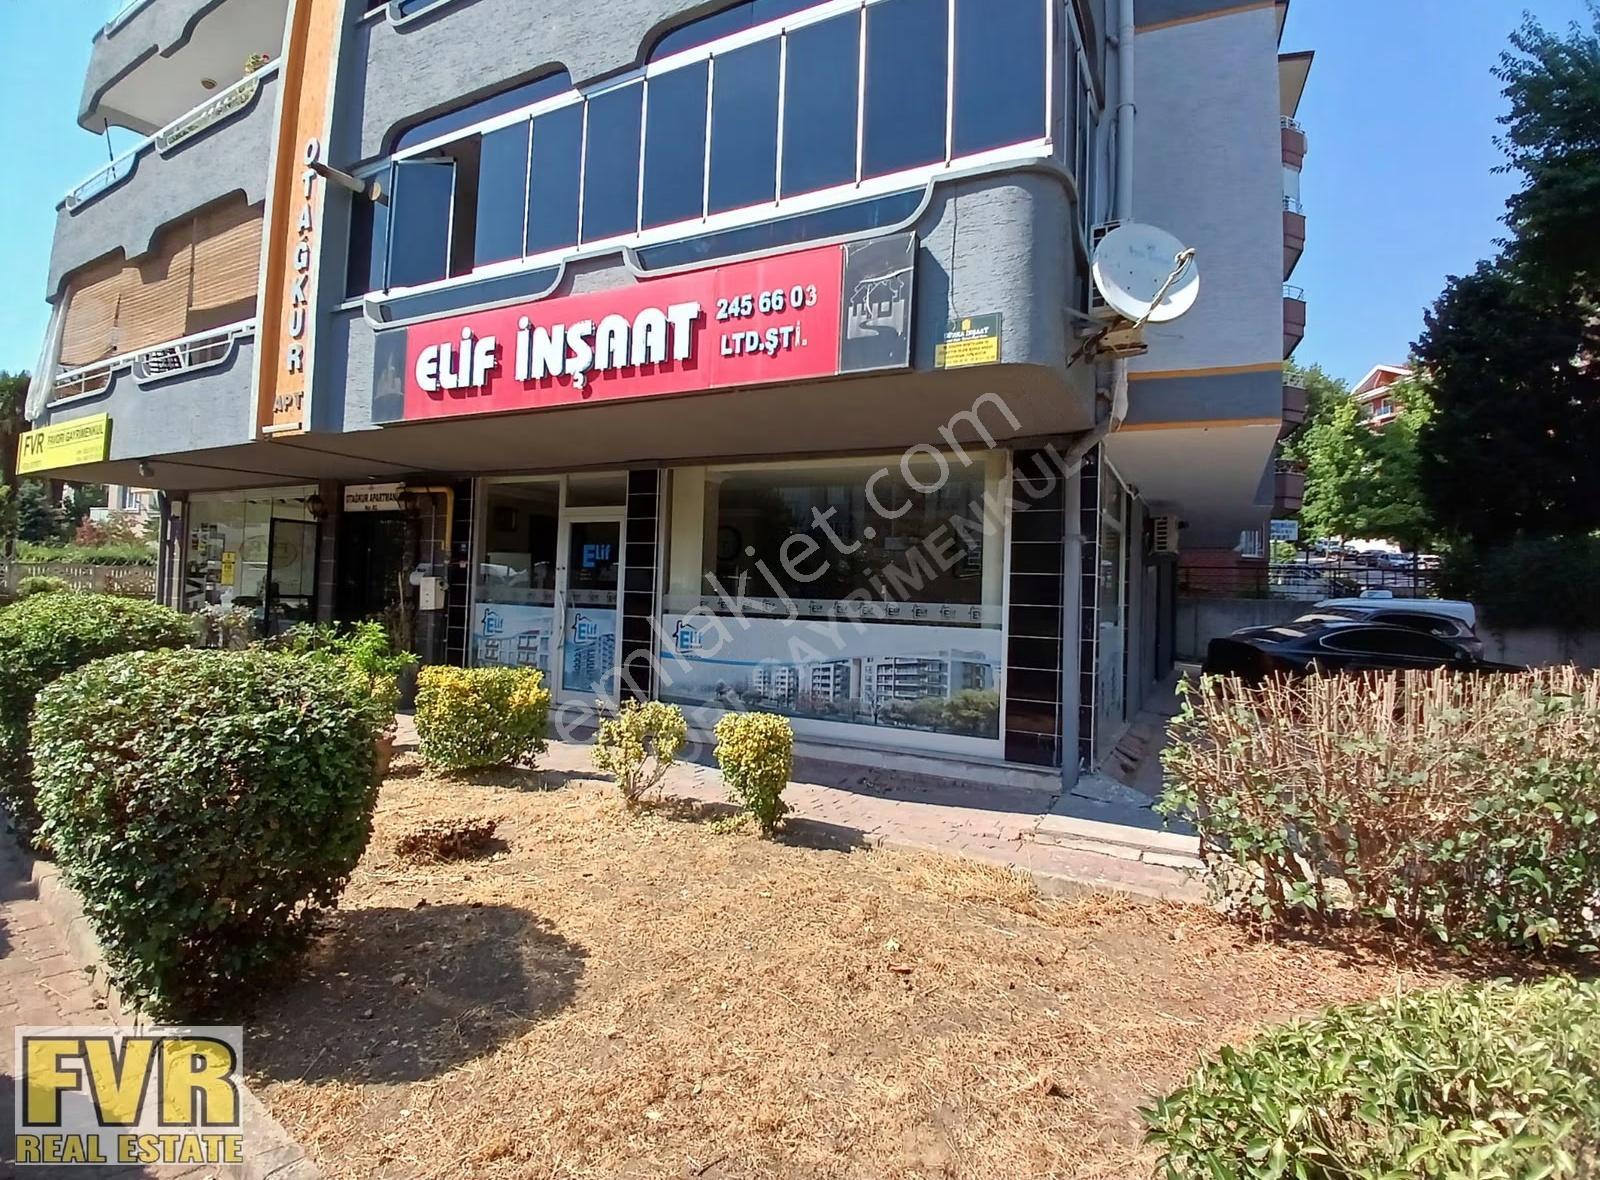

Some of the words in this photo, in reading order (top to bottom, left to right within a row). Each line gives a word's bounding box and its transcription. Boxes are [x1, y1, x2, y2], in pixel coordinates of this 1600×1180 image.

[696, 294, 754, 322] 245
[758, 289, 785, 315] 66
[415, 326, 500, 394] ELİF
[514, 301, 704, 392] İNŞAAT
[273, 391, 305, 414] APT
[23, 432, 45, 458] FVR
